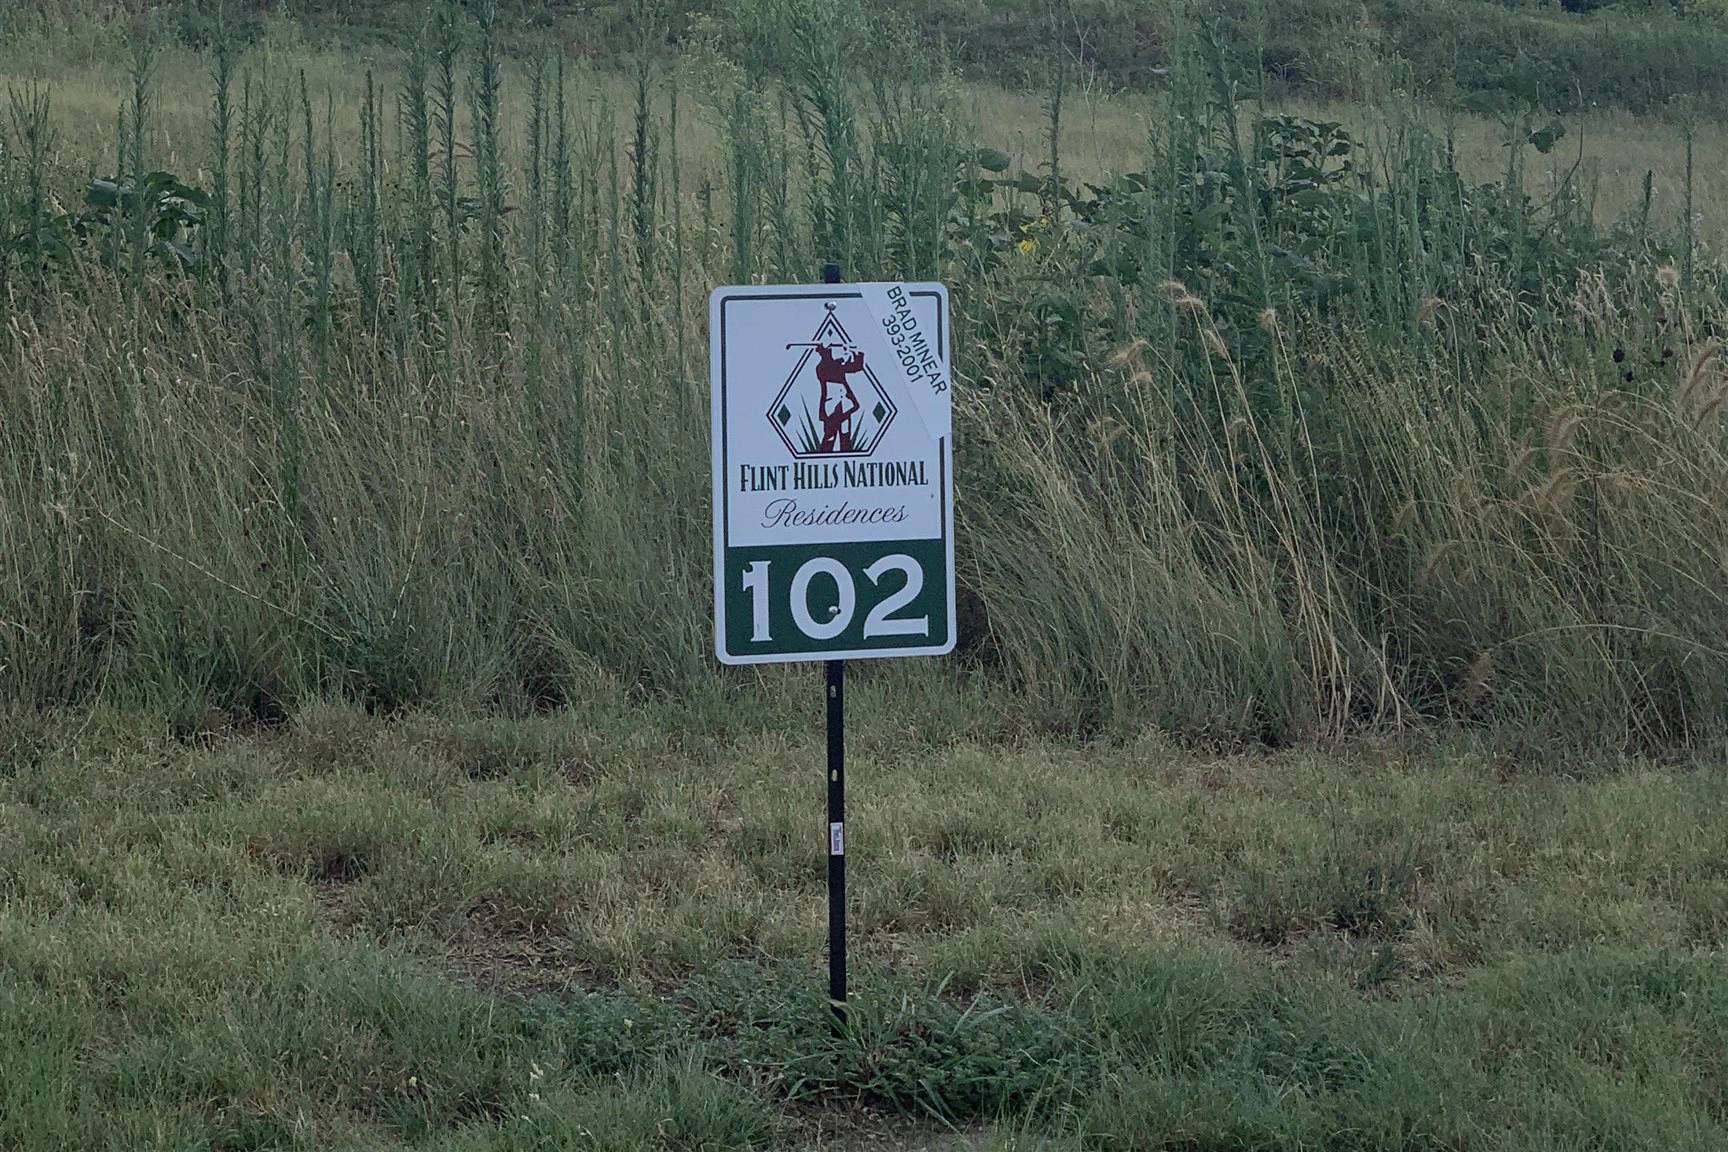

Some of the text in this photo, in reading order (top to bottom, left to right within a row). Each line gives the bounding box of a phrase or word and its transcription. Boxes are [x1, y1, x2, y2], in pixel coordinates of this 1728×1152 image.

[883, 314, 924, 383] 393-2001
[887, 286, 948, 395] BRAD MINEAR
[740, 460, 929, 492] FLINT HILLS NATIONAL
[761, 498, 908, 529] Residences
[742, 553, 929, 642] 102
